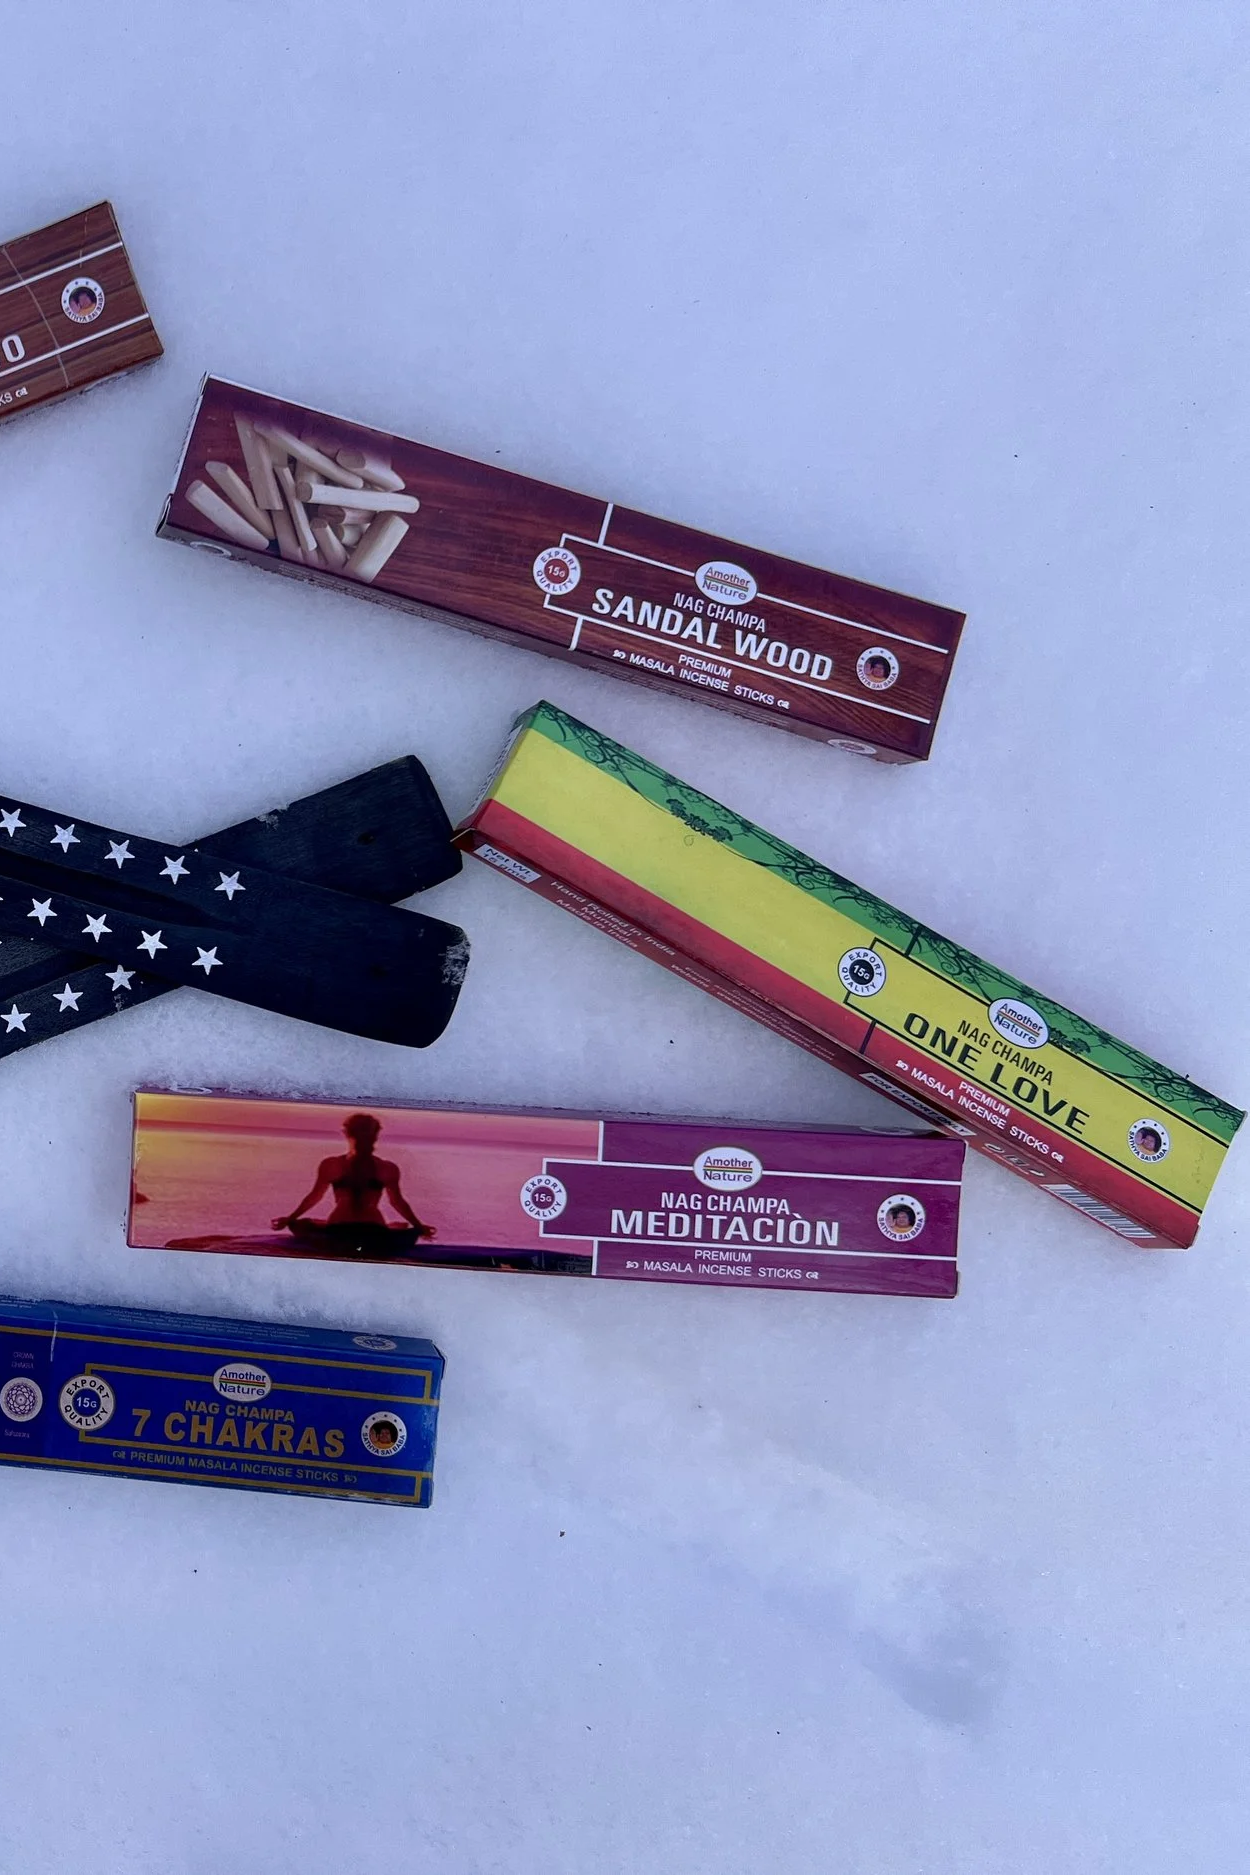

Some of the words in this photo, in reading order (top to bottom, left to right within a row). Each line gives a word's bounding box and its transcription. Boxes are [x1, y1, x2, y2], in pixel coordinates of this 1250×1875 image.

[541, 551, 577, 571] EXPORT
[537, 570, 573, 591] QUALITY
[706, 567, 750, 587] Amother
[702, 579, 747, 600] Nature
[673, 592, 703, 613] NAG
[707, 602, 766, 632] CHAMPA
[592, 588, 722, 650] SANDAL
[734, 629, 832, 681] WOOD
[678, 654, 732, 679] PREMIUM
[630, 653, 674, 675] MASALA
[680, 668, 729, 692] INCENSE
[734, 685, 774, 705] STICKS
[485, 848, 510, 863] Net
[550, 881, 587, 903] Hand
[587, 903, 629, 927] Rolled
[630, 928, 642, 936] in
[644, 936, 676, 955] India
[556, 899, 592, 921] Made
[607, 928, 637, 948] India
[581, 906, 633, 937] Mumbai
[849, 952, 882, 976] EXPORT
[842, 967, 876, 992] QUALITY
[1000, 1003, 1043, 1032] Amother
[994, 1015, 1037, 1045] Nature
[957, 1020, 990, 1048] NAG
[992, 1040, 1053, 1085] CHAMPA
[903, 1013, 982, 1071] ONE
[990, 1063, 1090, 1134] LOVE
[868, 1075, 891, 1089] FOR
[892, 1089, 937, 1116] EXPORT
[937, 1115, 970, 1133] ONLY
[959, 1081, 1010, 1116] PREMIUM
[911, 1068, 954, 1100] MASALA
[958, 1095, 1006, 1130] INCENSE
[1010, 1125, 1049, 1154] STICKS
[704, 1156, 753, 1167] Amother
[526, 1179, 562, 1193] EXPORT
[703, 1171, 752, 1182] Nature
[525, 1200, 561, 1217] QUALITY
[661, 1192, 702, 1210] NAG
[707, 1195, 790, 1215] CHAMPA
[695, 1250, 751, 1262] PREMIUM
[644, 1261, 692, 1273] MASALA
[699, 1264, 751, 1276] INCENSE
[758, 1267, 801, 1279] STICKS
[220, 1369, 266, 1381] Amother
[66, 1379, 109, 1398] EXPORT
[219, 1382, 265, 1396] Nature
[77, 1397, 97, 1408] 15G
[185, 1400, 219, 1414] NAG
[225, 1404, 295, 1423] CHAMPA
[65, 1405, 108, 1426] QUALITY
[132, 1408, 151, 1436] 7
[164, 1412, 345, 1458] CHAKRAS
[130, 1451, 185, 1466] PREMIUM
[189, 1457, 238, 1471] MASALA
[241, 1463, 292, 1477] INCENSE
[296, 1469, 338, 1482] STICKS
